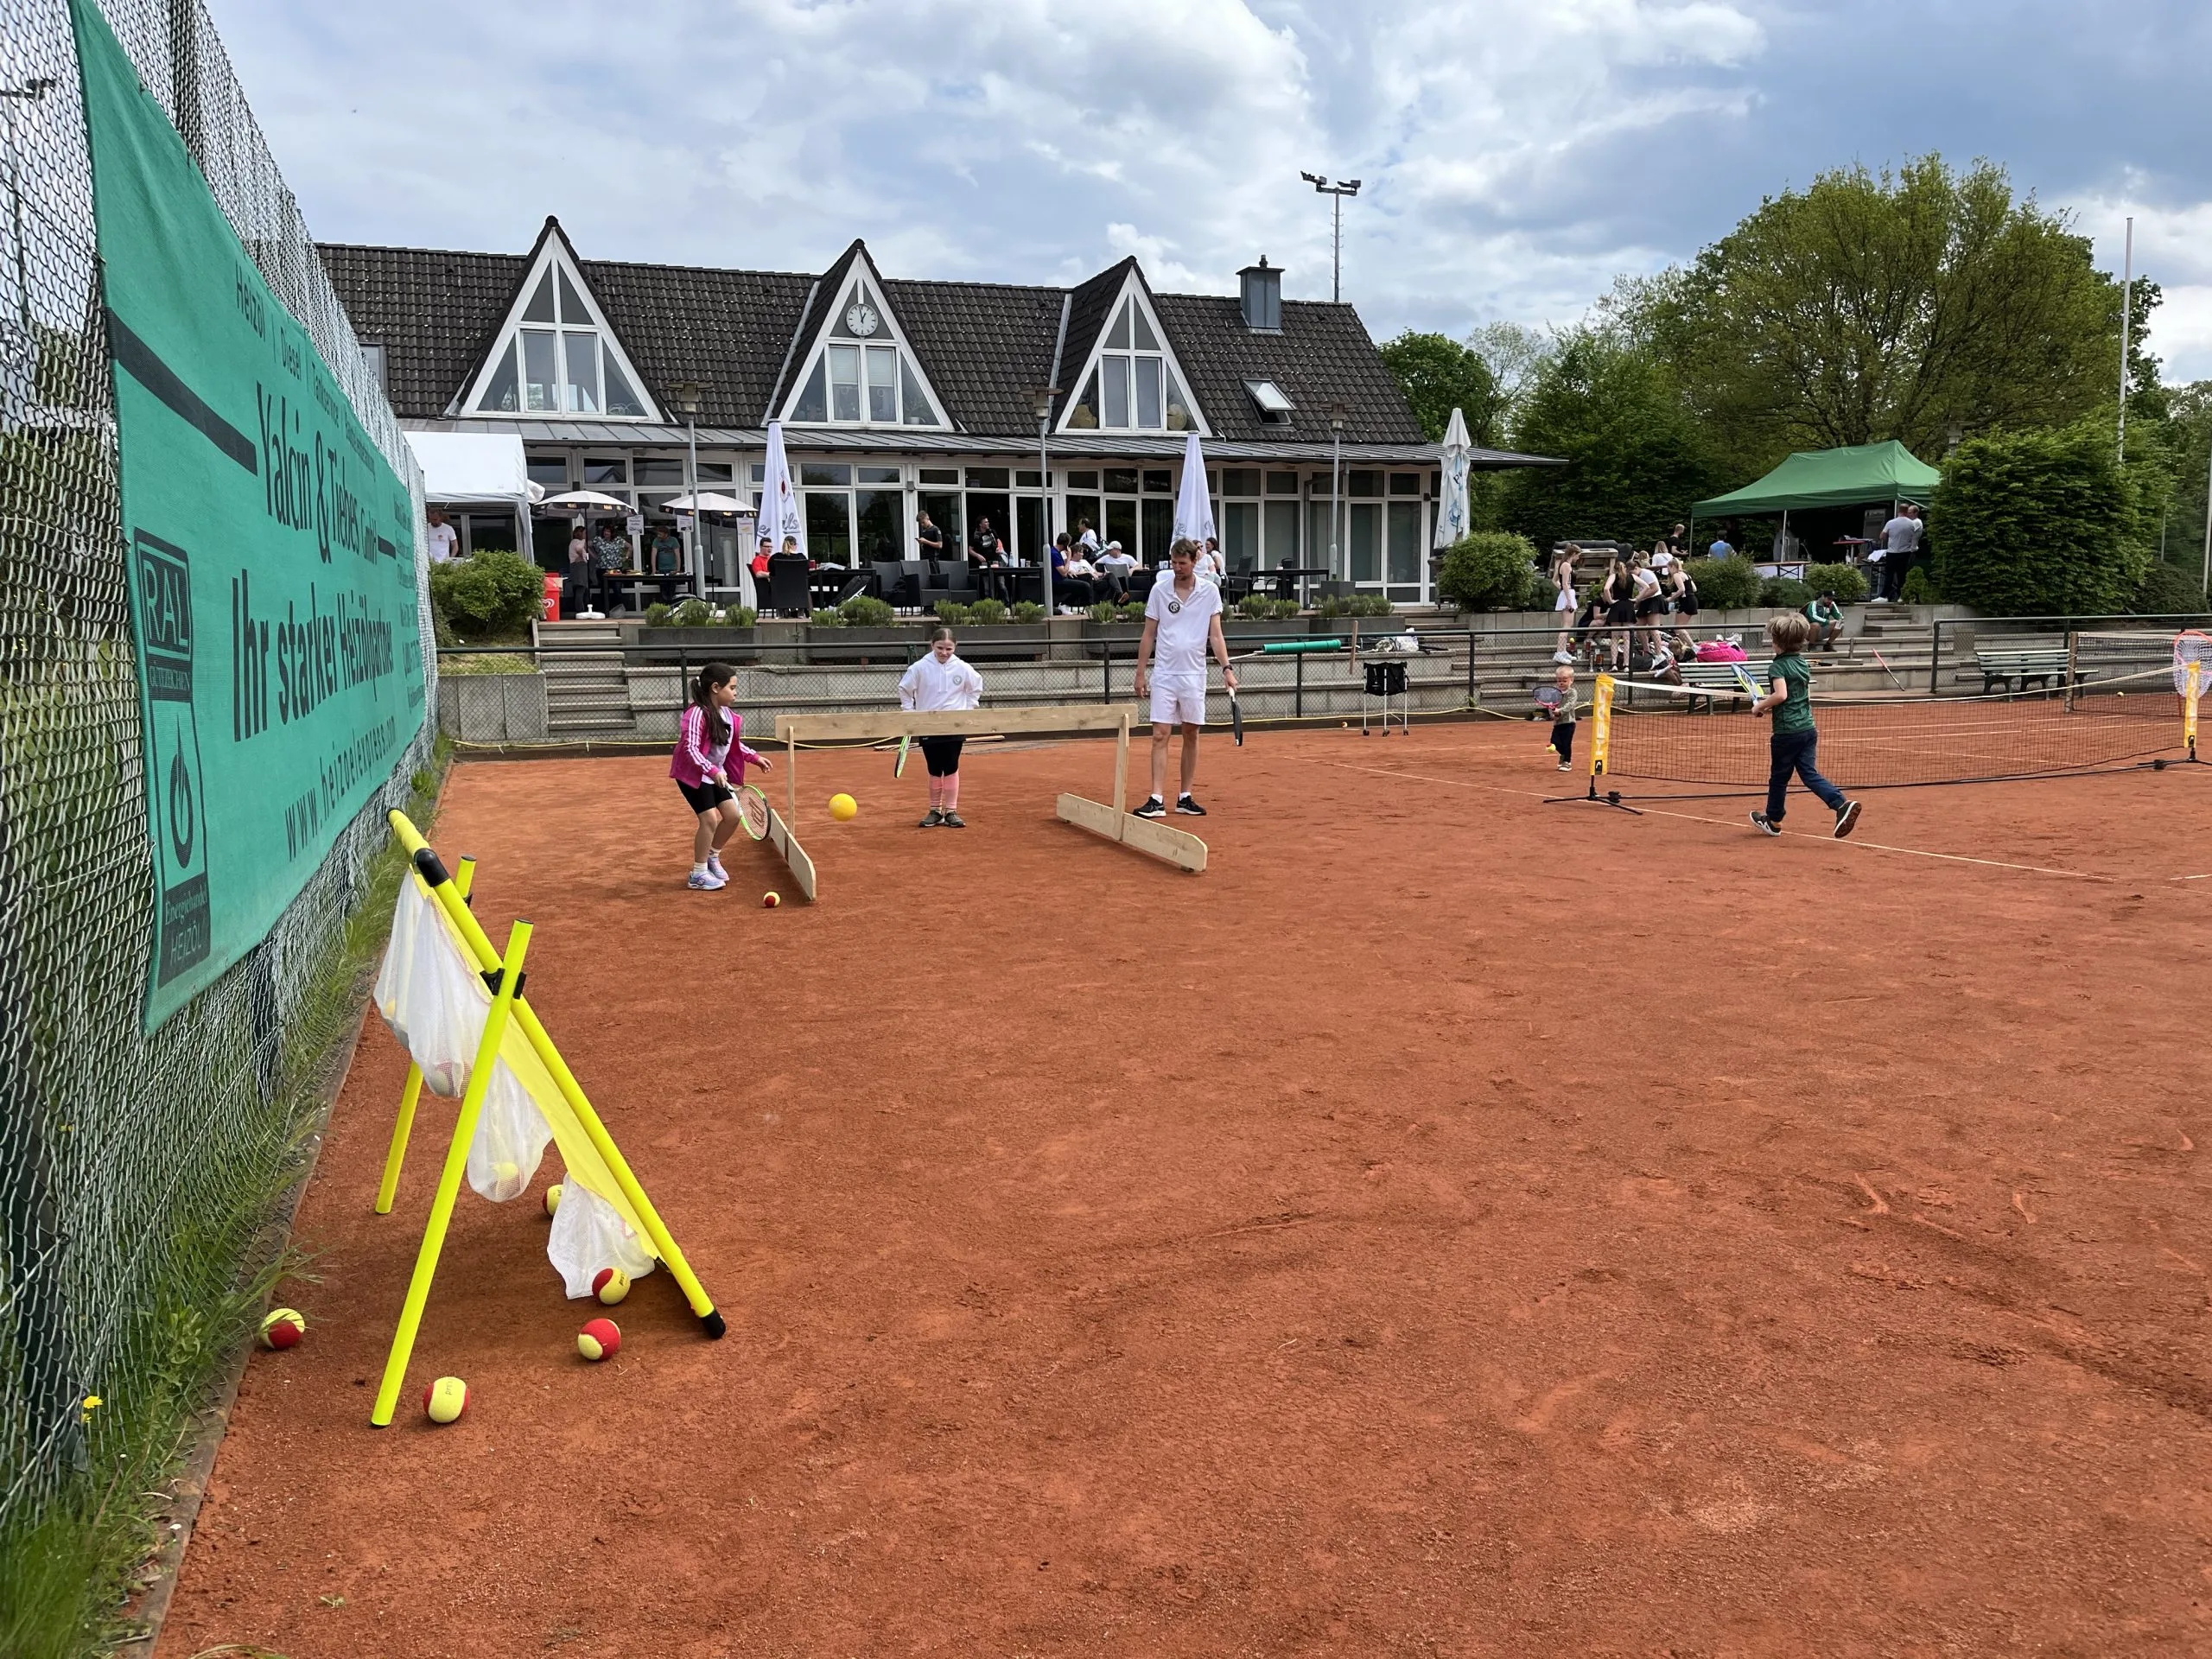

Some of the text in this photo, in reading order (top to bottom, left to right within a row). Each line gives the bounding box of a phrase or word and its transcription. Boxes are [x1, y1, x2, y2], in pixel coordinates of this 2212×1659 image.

[235, 259, 266, 343] Heizöl
[280, 326, 302, 380] Diesel
[256, 379, 313, 532] Yalcin
[315, 429, 332, 564] &
[327, 447, 359, 556] Tiebes
[143, 559, 188, 647] RAL
[232, 568, 395, 743] Ihr starker Heizölpartner
[169, 919, 202, 967] HEIZÖL
